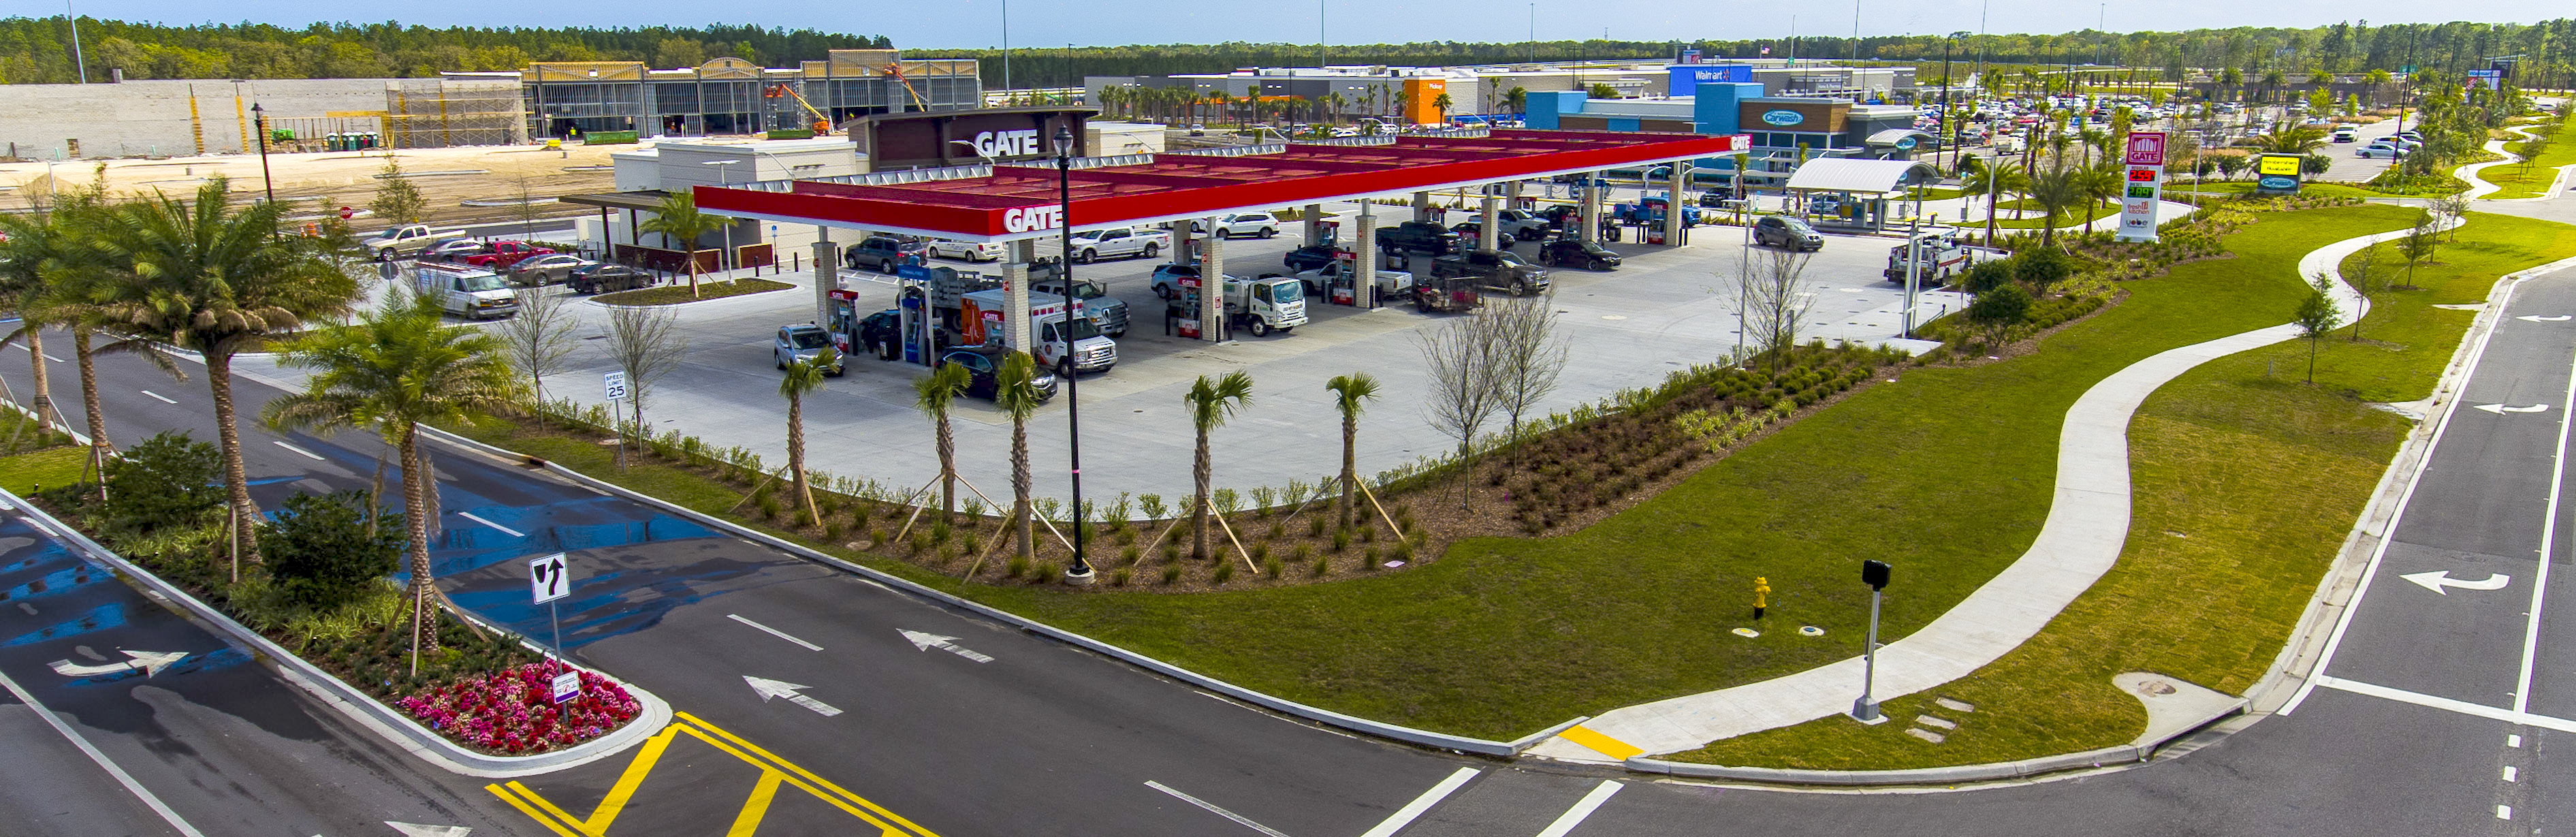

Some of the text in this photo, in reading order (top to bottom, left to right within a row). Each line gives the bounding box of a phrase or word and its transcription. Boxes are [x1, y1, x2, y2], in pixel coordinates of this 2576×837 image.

[1695, 70, 1723, 80] Walmart
[1765, 114, 1798, 123] Carwash
[975, 129, 1038, 158] GATE
[1731, 136, 1751, 151] GATE
[2131, 152, 2158, 161] GATE
[1004, 204, 1062, 233] GATE
[984, 313, 999, 321] GATE
[608, 385, 624, 398] 25
